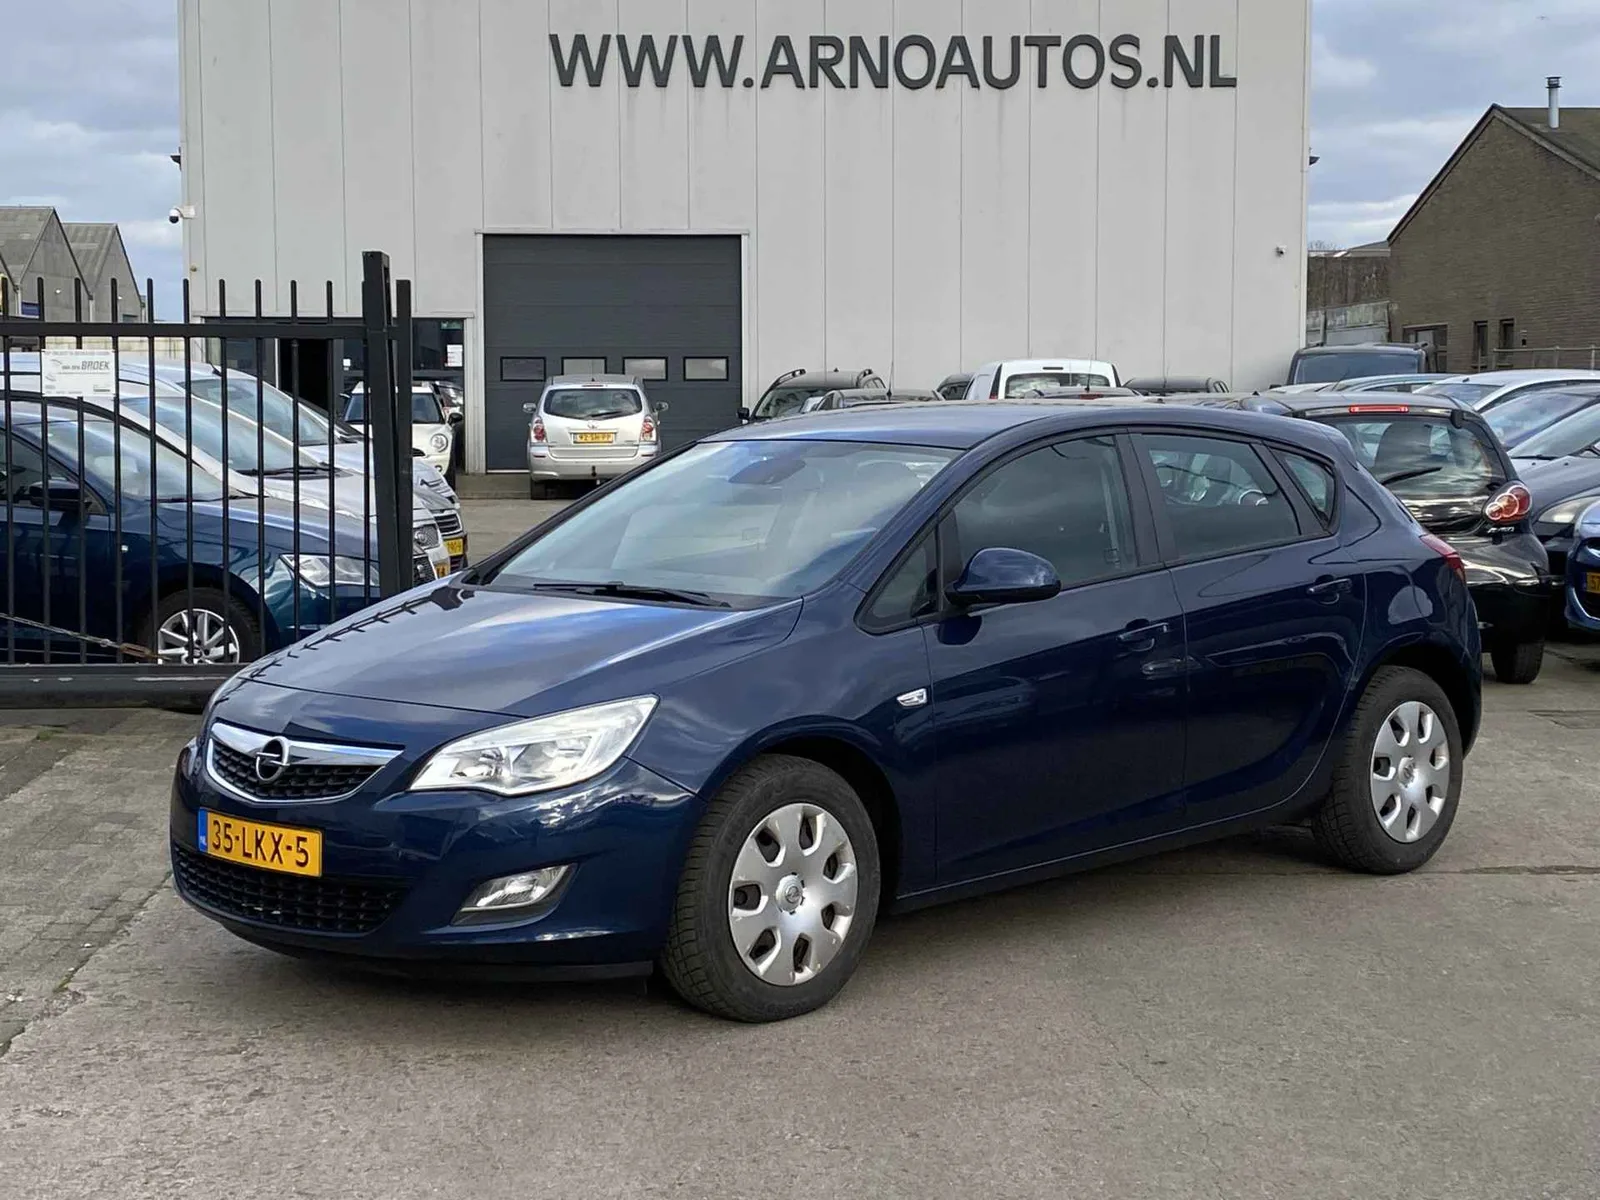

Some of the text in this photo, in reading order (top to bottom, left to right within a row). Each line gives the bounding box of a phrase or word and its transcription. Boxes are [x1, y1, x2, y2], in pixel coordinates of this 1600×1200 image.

[549, 34, 1237, 90] WWW.ARNOAUTOS.NL
[81, 360, 110, 371] BROEK
[212, 819, 309, 868] 35-LKX-5
